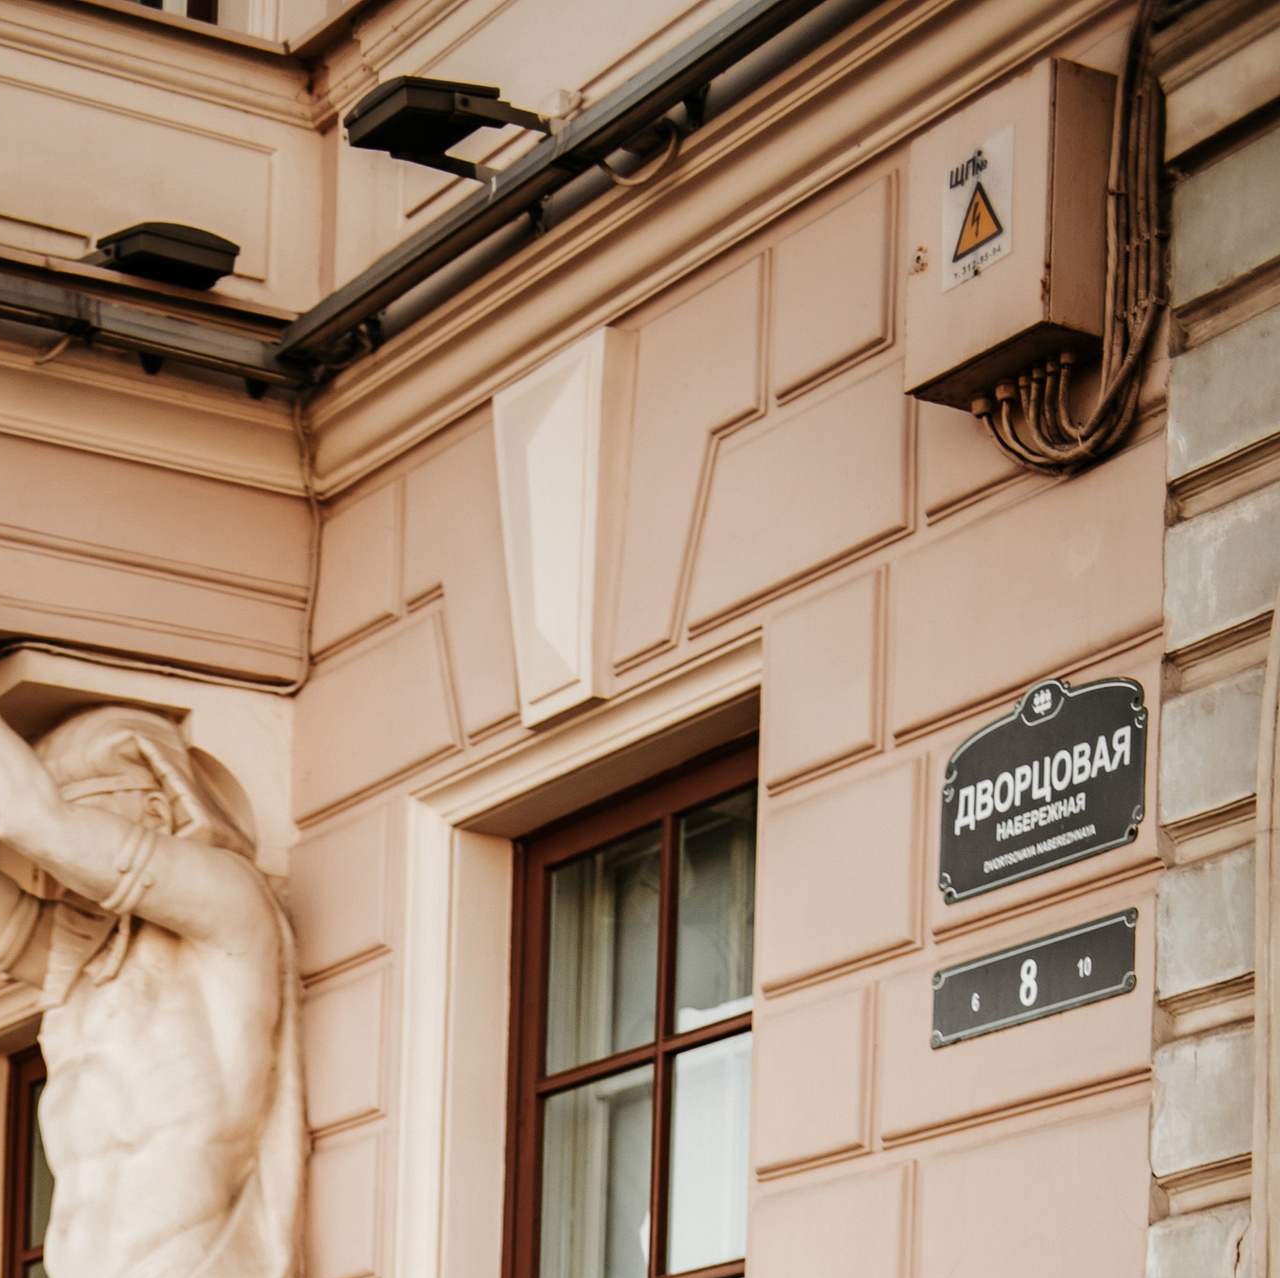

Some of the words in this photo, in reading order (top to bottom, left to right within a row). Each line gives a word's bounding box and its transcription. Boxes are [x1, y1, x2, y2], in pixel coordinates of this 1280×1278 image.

[954, 725, 1132, 836] ДВОРЦОВАЯ
[995, 792, 1087, 842] НАБЕРЕЖНАЯ
[971, 992, 981, 1012] 6
[1019, 958, 1038, 1007] 8
[1077, 956, 1092, 978] 10
